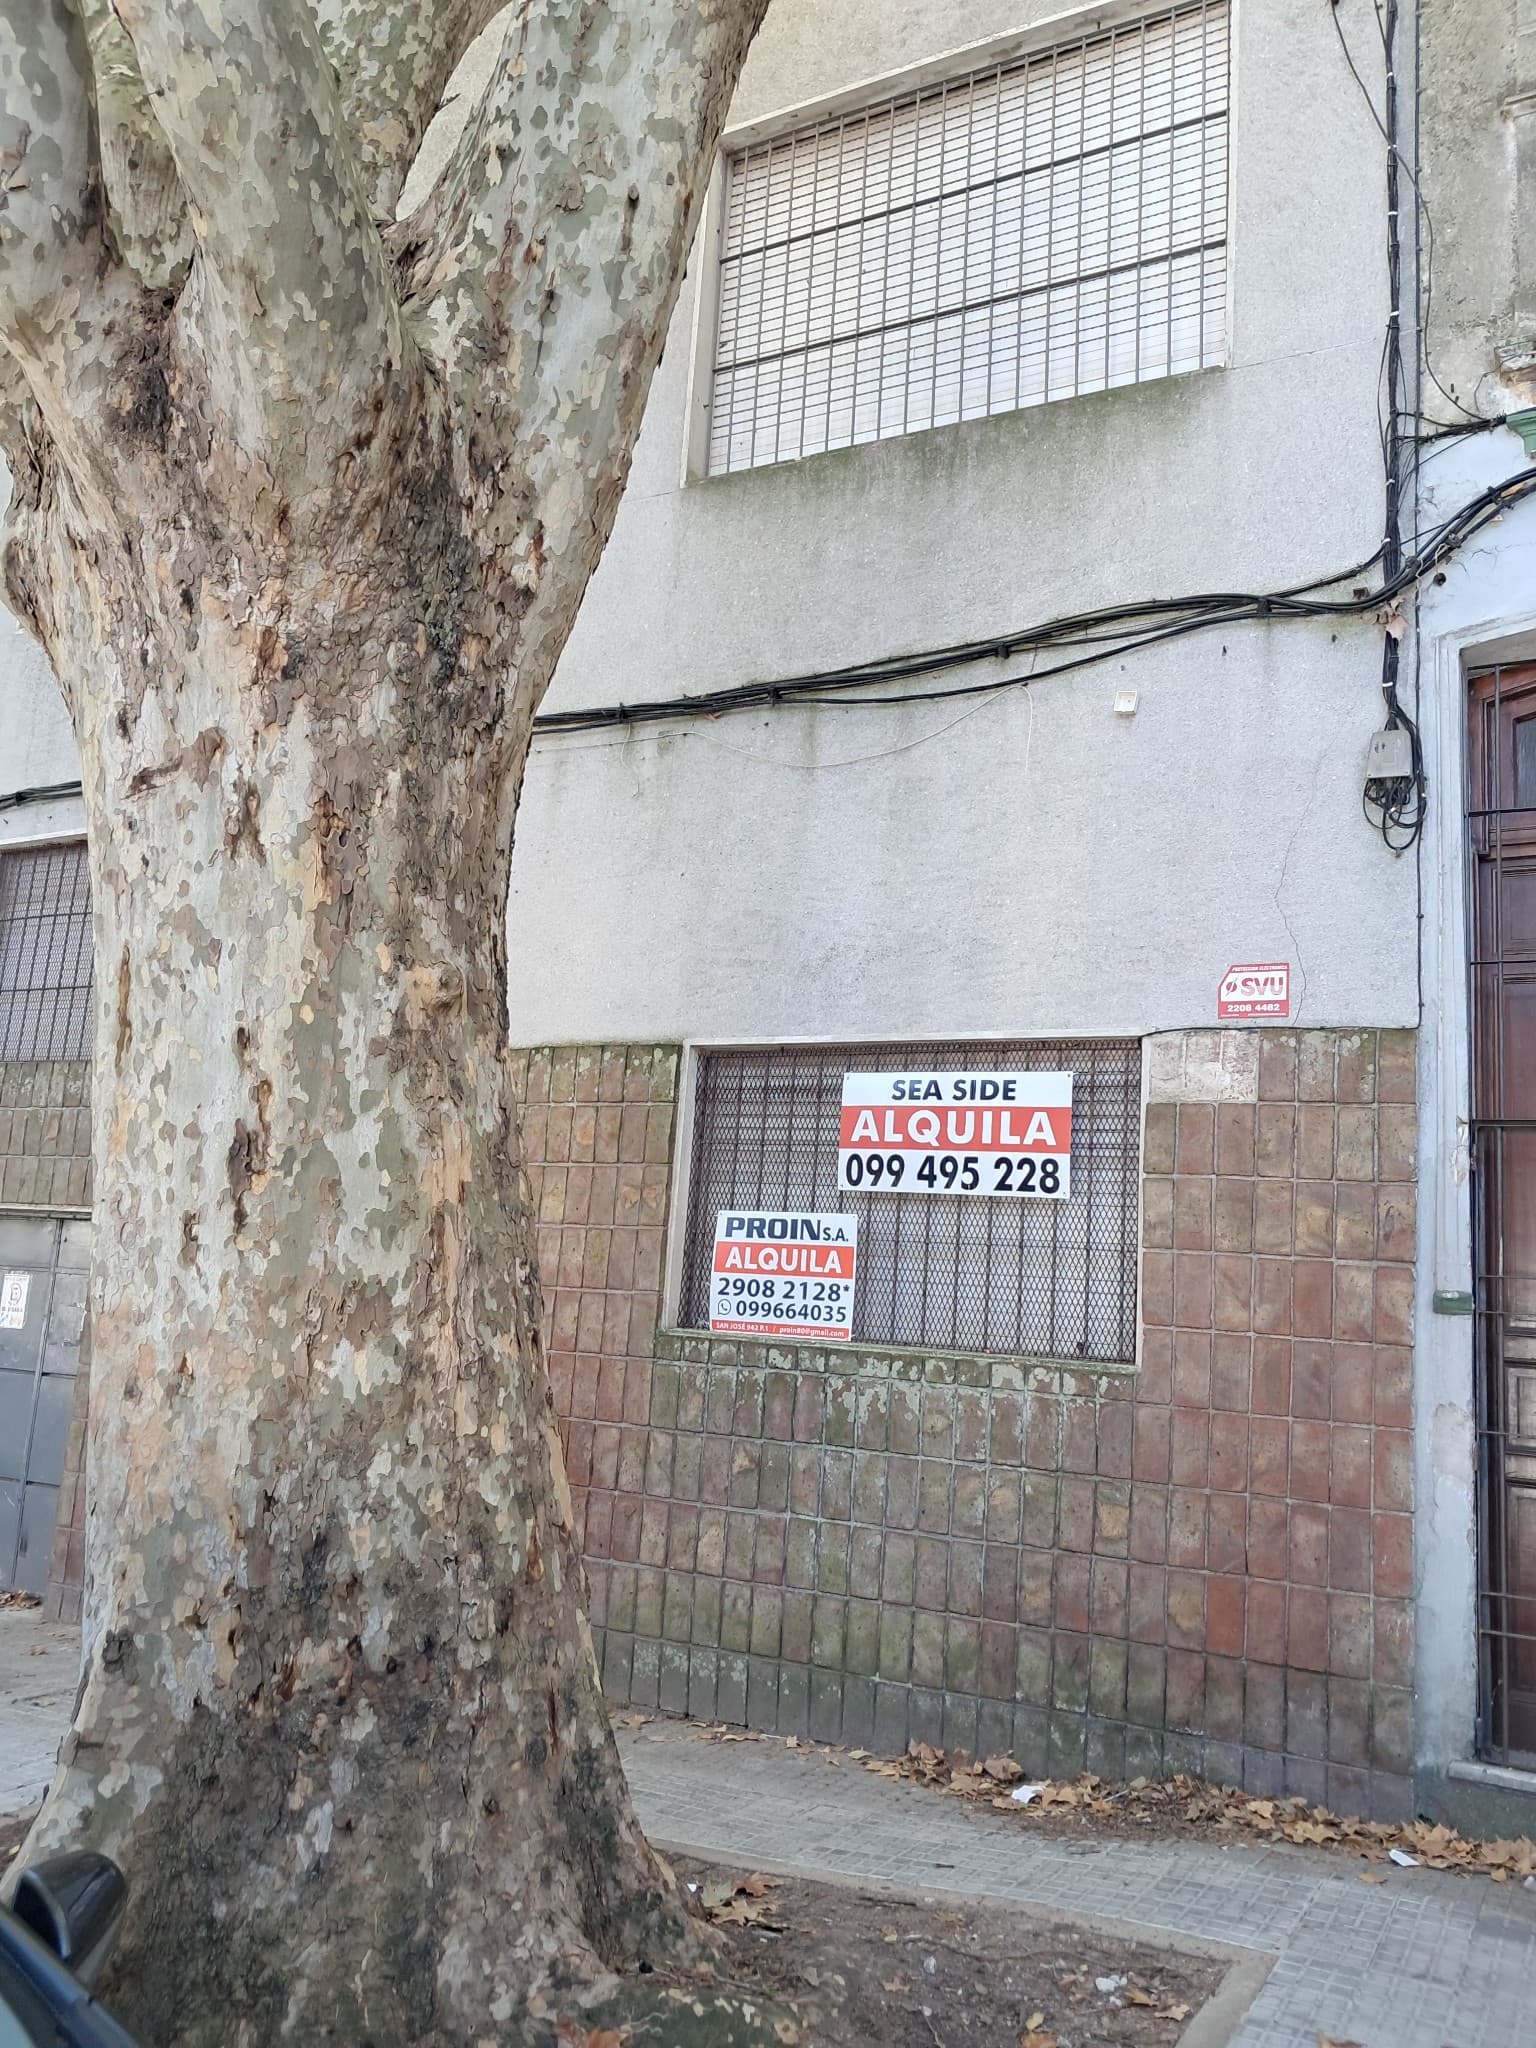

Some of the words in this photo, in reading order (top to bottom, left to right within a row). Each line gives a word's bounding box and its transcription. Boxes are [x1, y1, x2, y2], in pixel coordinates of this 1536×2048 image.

[1241, 977, 1284, 996] SVU
[891, 1079, 943, 1101] SEA
[952, 1079, 1017, 1101] SIDE
[850, 1109, 1057, 1147] ALQUILA
[845, 1153, 905, 1188] 099
[917, 1155, 980, 1191] 495
[993, 1156, 1061, 1194] 228
[725, 1216, 821, 1241] PROIN
[822, 1227, 849, 1242] S.A.
[724, 1246, 842, 1274] ALQUILA
[717, 1277, 776, 1298] 2908
[736, 1300, 847, 1323] 099664035
